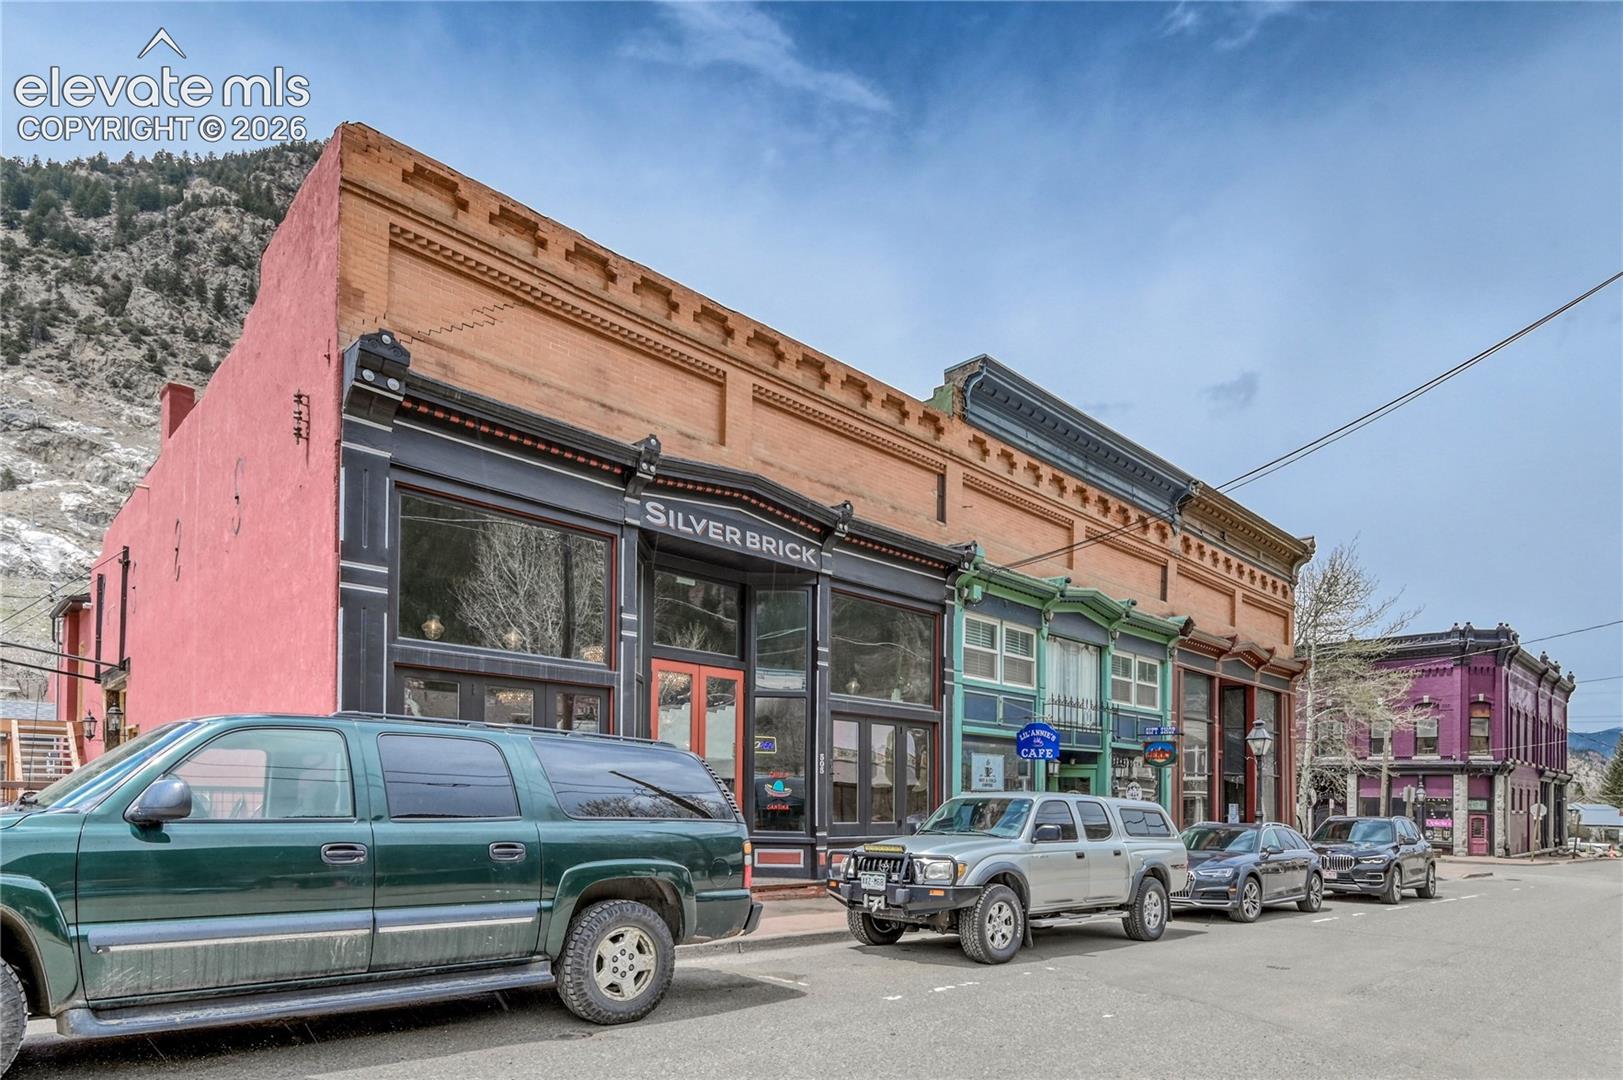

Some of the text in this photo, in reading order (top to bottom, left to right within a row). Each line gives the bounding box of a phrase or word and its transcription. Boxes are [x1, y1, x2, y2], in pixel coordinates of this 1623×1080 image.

[1145, 726, 1176, 735] GIFT SHOP
[1021, 748, 1053, 758] CAFE
